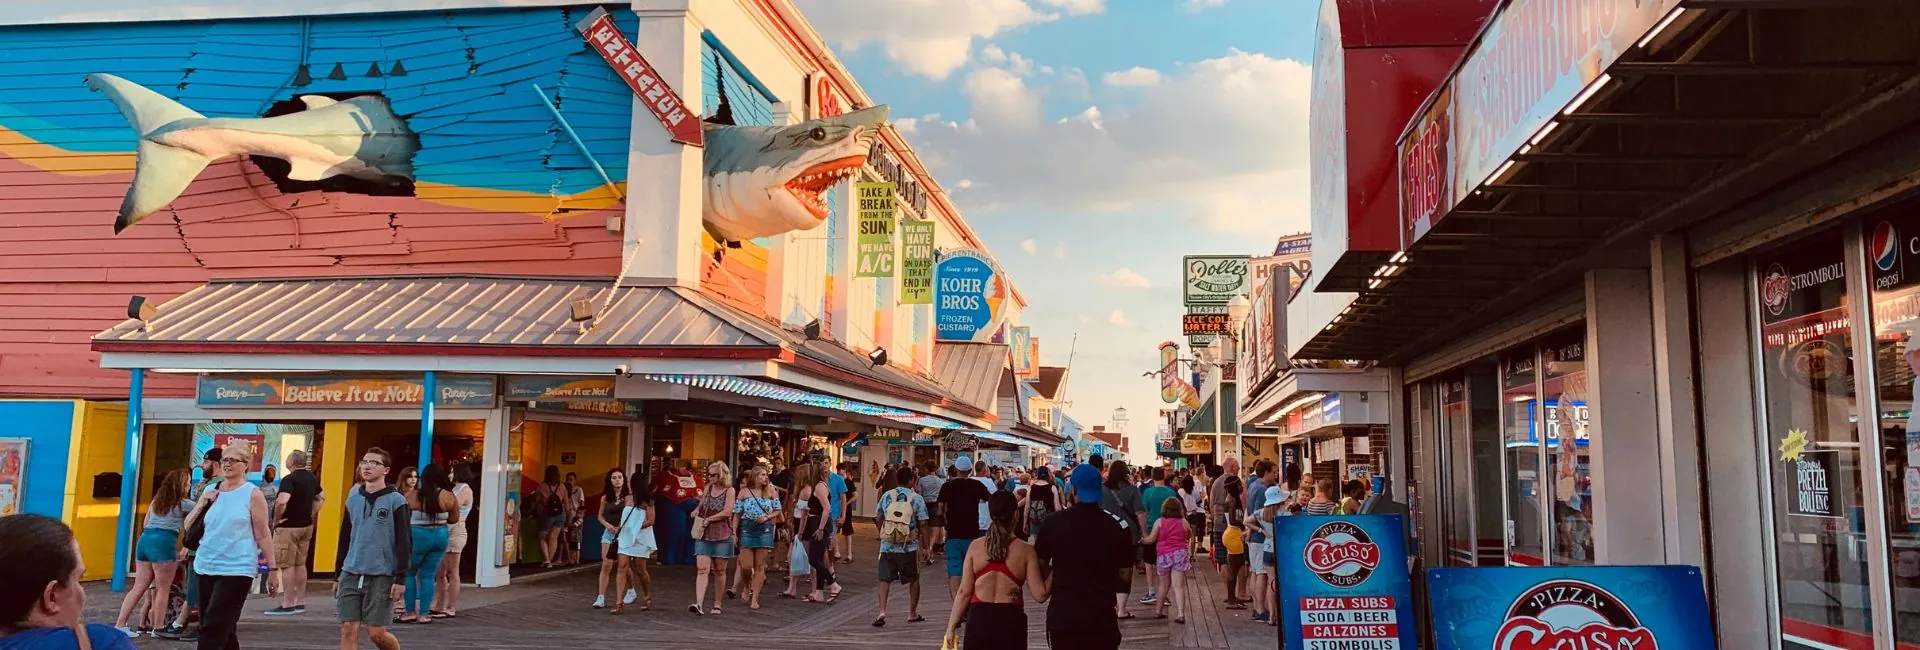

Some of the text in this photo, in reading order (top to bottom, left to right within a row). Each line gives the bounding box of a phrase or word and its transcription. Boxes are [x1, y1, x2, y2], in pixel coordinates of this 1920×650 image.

[594, 26, 686, 127] ENTRANCE
[1477, 0, 1618, 160] STROMBO
[1407, 121, 1440, 230] FRIES
[860, 187, 892, 197] TAKE A
[860, 199, 892, 210] BREAK
[860, 211, 893, 219] FROM THE
[860, 221, 893, 235] SUN.
[904, 225, 933, 233] WE ONLY
[906, 233, 931, 244] HAVE
[861, 243, 894, 252] WE HAVE
[905, 245, 930, 258] FUN
[859, 253, 892, 273] A/C
[914, 260, 931, 268] DAYS
[908, 268, 926, 276] THAT
[1189, 259, 1248, 283] Dolle's
[904, 278, 931, 287] END IN
[1790, 262, 1845, 292] STROMBOLI
[1876, 270, 1899, 290] pepsi
[941, 277, 982, 293] KOHR
[941, 295, 980, 310] BROS
[941, 315, 973, 323] FROZEN
[1187, 316, 1205, 324] ICE
[938, 323, 975, 331] CUSTARD
[284, 385, 419, 402] Believe It or Not!
[545, 387, 573, 396] Believe
[873, 426, 900, 437] ATM
[1797, 469, 1828, 491] PRETZEL
[1323, 524, 1354, 535] PIZZA
[1307, 541, 1375, 570] Caruso
[1331, 575, 1358, 585] SUBS
[1306, 597, 1388, 609] PIZZA SUBS
[1536, 587, 1598, 610] PIZZA
[1308, 612, 1389, 622] SODA BEER
[1313, 625, 1387, 637] CALZONES
[1311, 640, 1393, 650] STOMBOLIS
